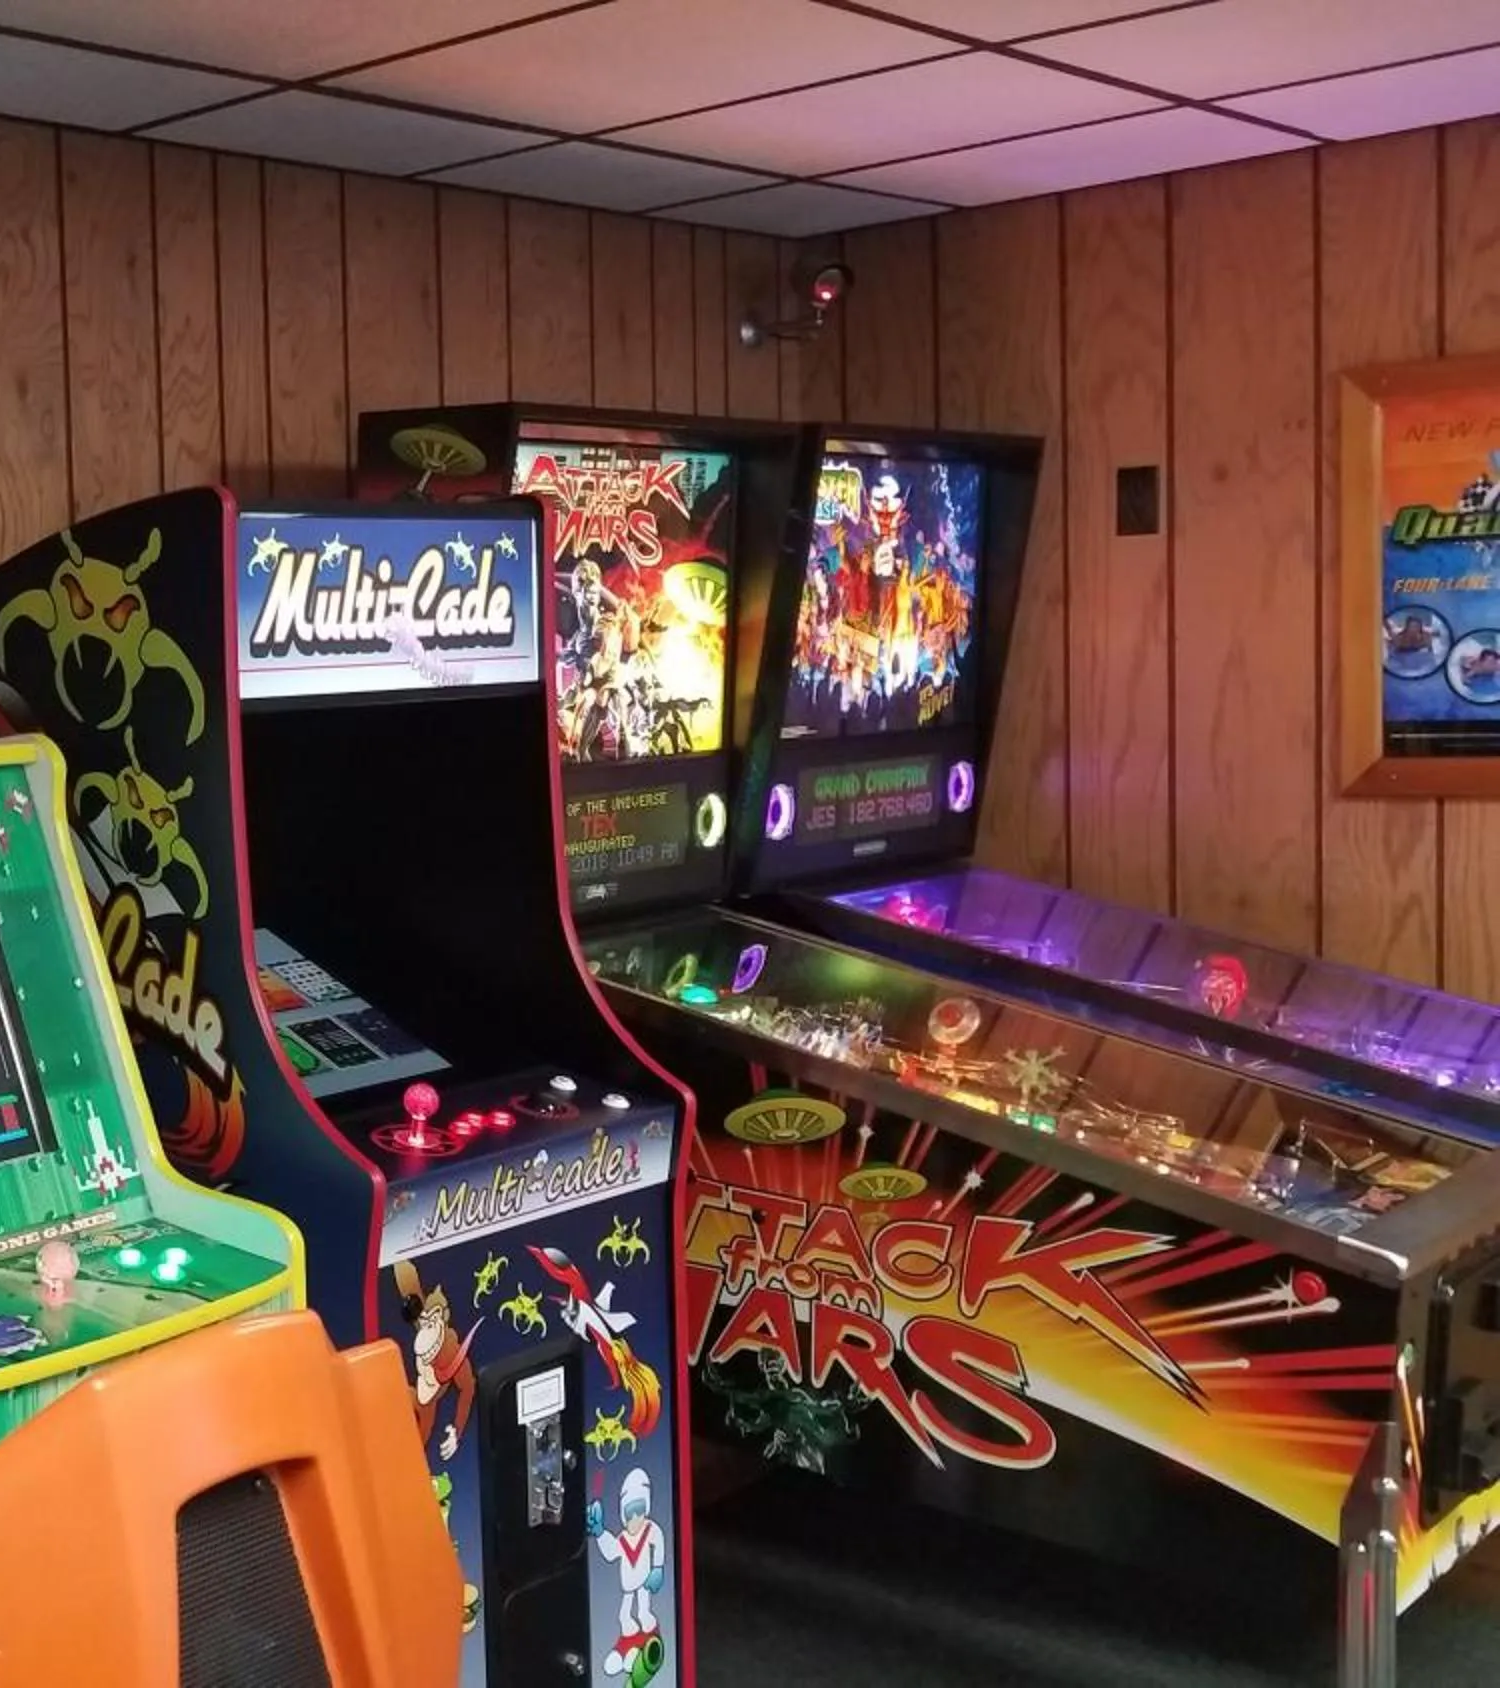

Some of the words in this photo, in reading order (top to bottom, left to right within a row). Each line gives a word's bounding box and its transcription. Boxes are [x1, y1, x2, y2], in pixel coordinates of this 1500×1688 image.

[1404, 420, 1476, 442] NEW
[518, 454, 691, 521] ATTACK
[566, 803, 582, 817] OF
[586, 799, 608, 814] THE
[611, 791, 668, 811] UNIVERSE
[564, 835, 637, 857] NAUGURATED
[430, 1134, 624, 1239] Multicade
[42, 1211, 117, 1240] GAMES
[721, 1236, 884, 1323] from
